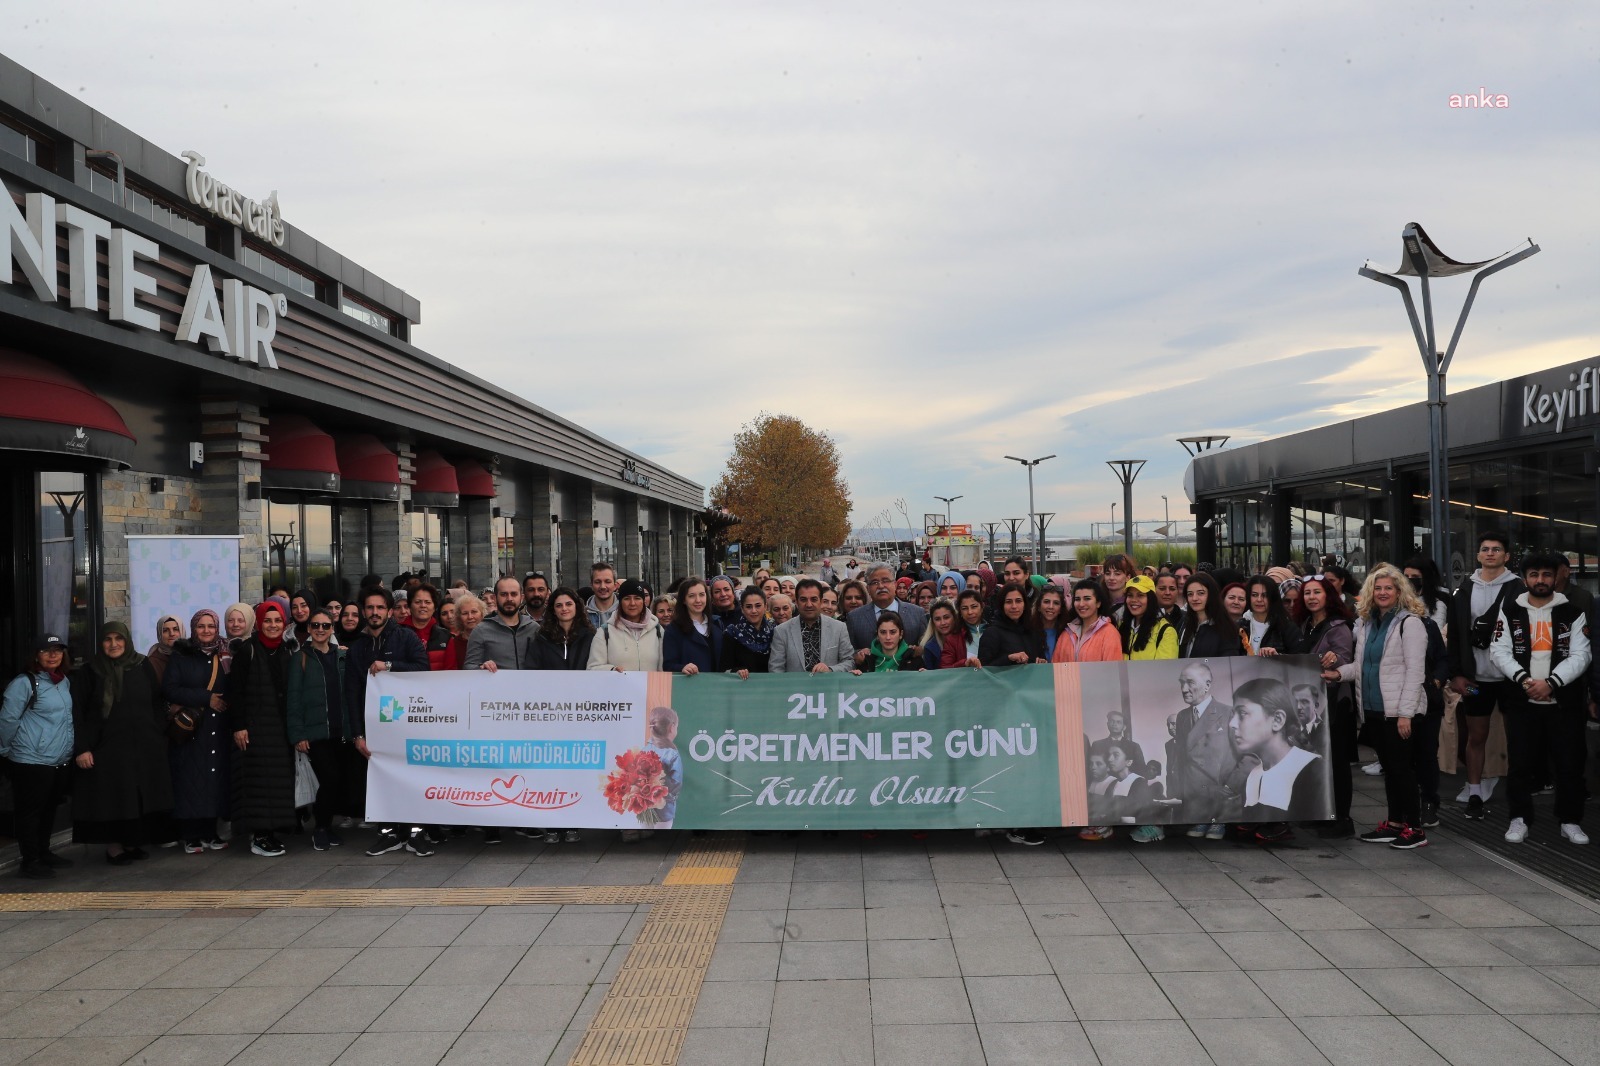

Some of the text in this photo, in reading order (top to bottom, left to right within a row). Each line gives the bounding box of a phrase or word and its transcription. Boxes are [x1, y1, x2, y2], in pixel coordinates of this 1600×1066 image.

[181, 150, 243, 226] Teras
[1523, 366, 1600, 434] Keyifl
[408, 696, 427, 704] T.C.
[408, 705, 433, 713] İZMİT
[480, 700, 633, 712] FATMA KAPLAN HÜRRİYET
[787, 692, 936, 719] 24 Kasım
[407, 714, 458, 723] BELEDİYESİ
[492, 712, 622, 723] İZMİT BELEDİYE BAŞKANI
[688, 722, 1037, 762] ÖĞRETMENLER GÜNÜ
[412, 742, 601, 766] SPOR İŞLERİ MÜDÜRLÜĞÜ
[424, 786, 569, 805] Gülümse İZMİT
[755, 774, 970, 806] Kutlu Olsun
